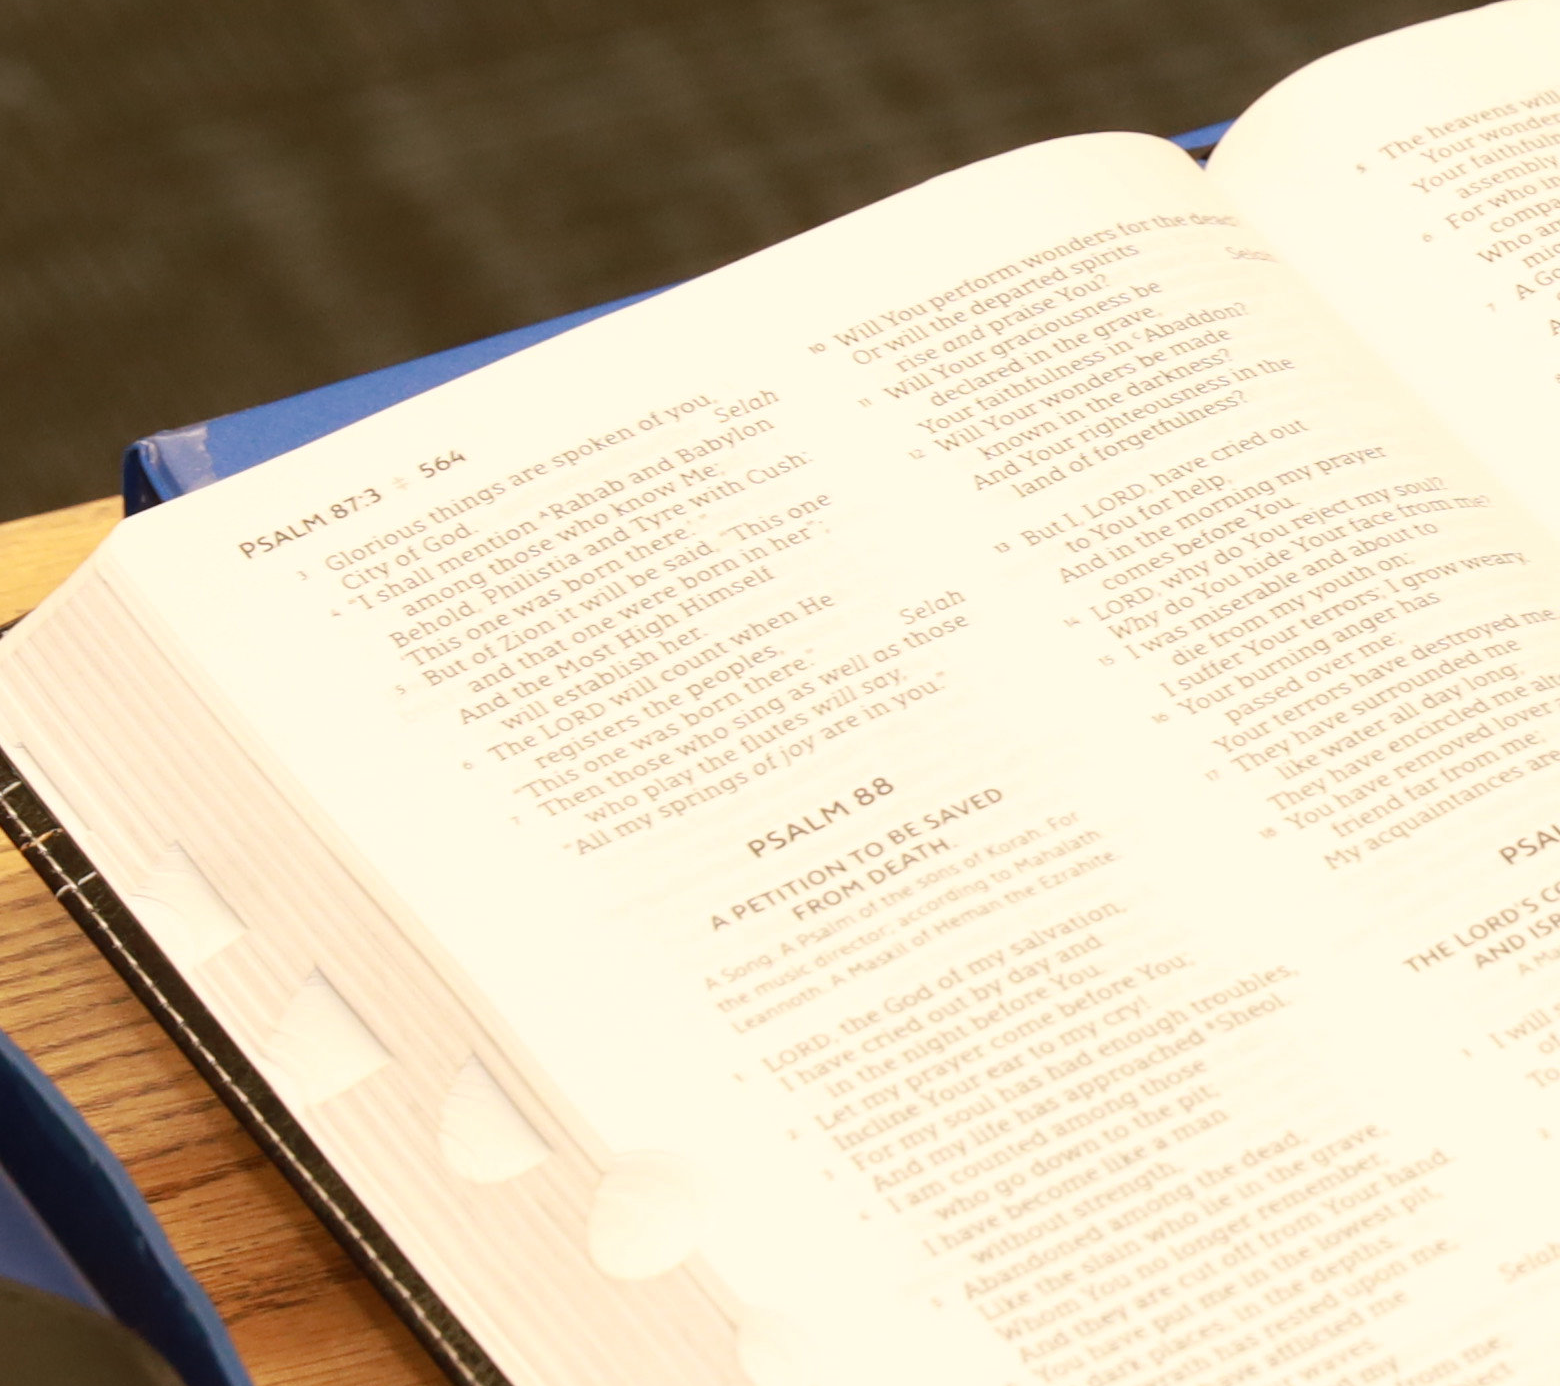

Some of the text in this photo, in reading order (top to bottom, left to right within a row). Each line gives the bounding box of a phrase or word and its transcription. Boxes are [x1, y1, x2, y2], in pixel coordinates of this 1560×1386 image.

[713, 389, 780, 423] Selah
[237, 450, 466, 559] PSALM 87:3 564
[325, 394, 719, 571] Glorious things are spoken of you,
[746, 776, 894, 858] PSALM 88
[710, 787, 1003, 931] A PETITION TO BE SAVED
[791, 837, 957, 920] FROM DEATH.
[1402, 942, 1453, 972] THE
[1453, 898, 1539, 948] LORD'S
[1474, 934, 1526, 968] AND
